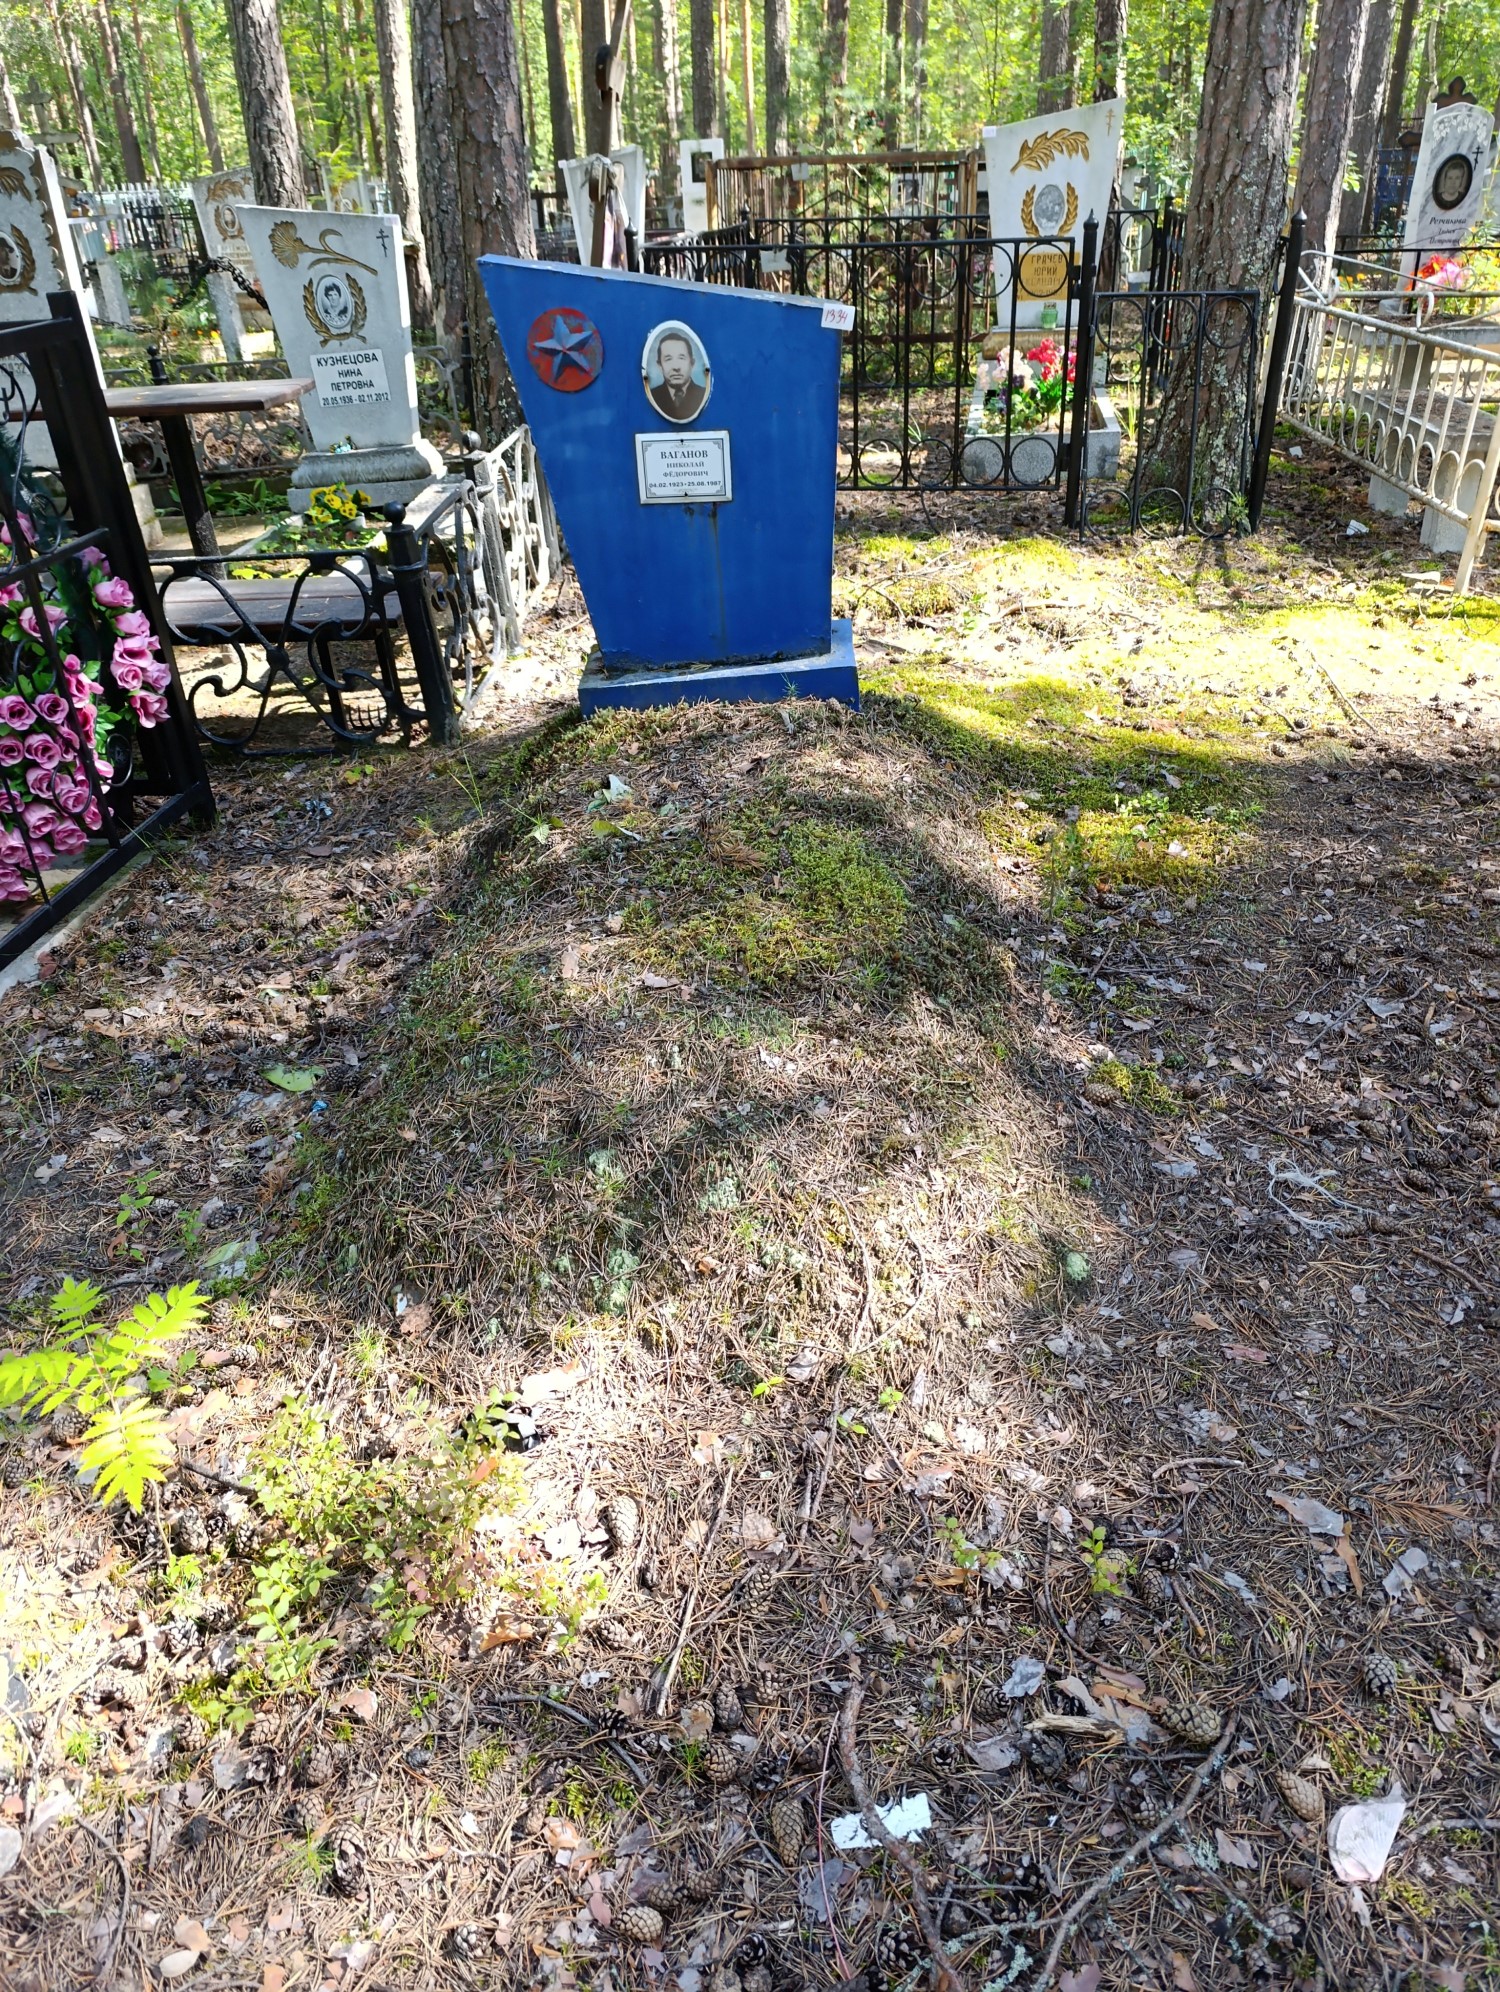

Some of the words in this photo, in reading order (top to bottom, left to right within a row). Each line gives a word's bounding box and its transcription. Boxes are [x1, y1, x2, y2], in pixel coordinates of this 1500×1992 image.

[825, 309, 848, 324] 1334
[316, 353, 378, 367] КУЗНЕЦОВА
[338, 368, 363, 378] НИНА
[331, 379, 374, 391] ПЕТРОВНА
[322, 395, 353, 406] 20.05.1936
[358, 392, 389, 403] 02.11.2012
[660, 450, 708, 459] ВАГАНОВ
[662, 469, 709, 478] ФЁДОРОВИЧ
